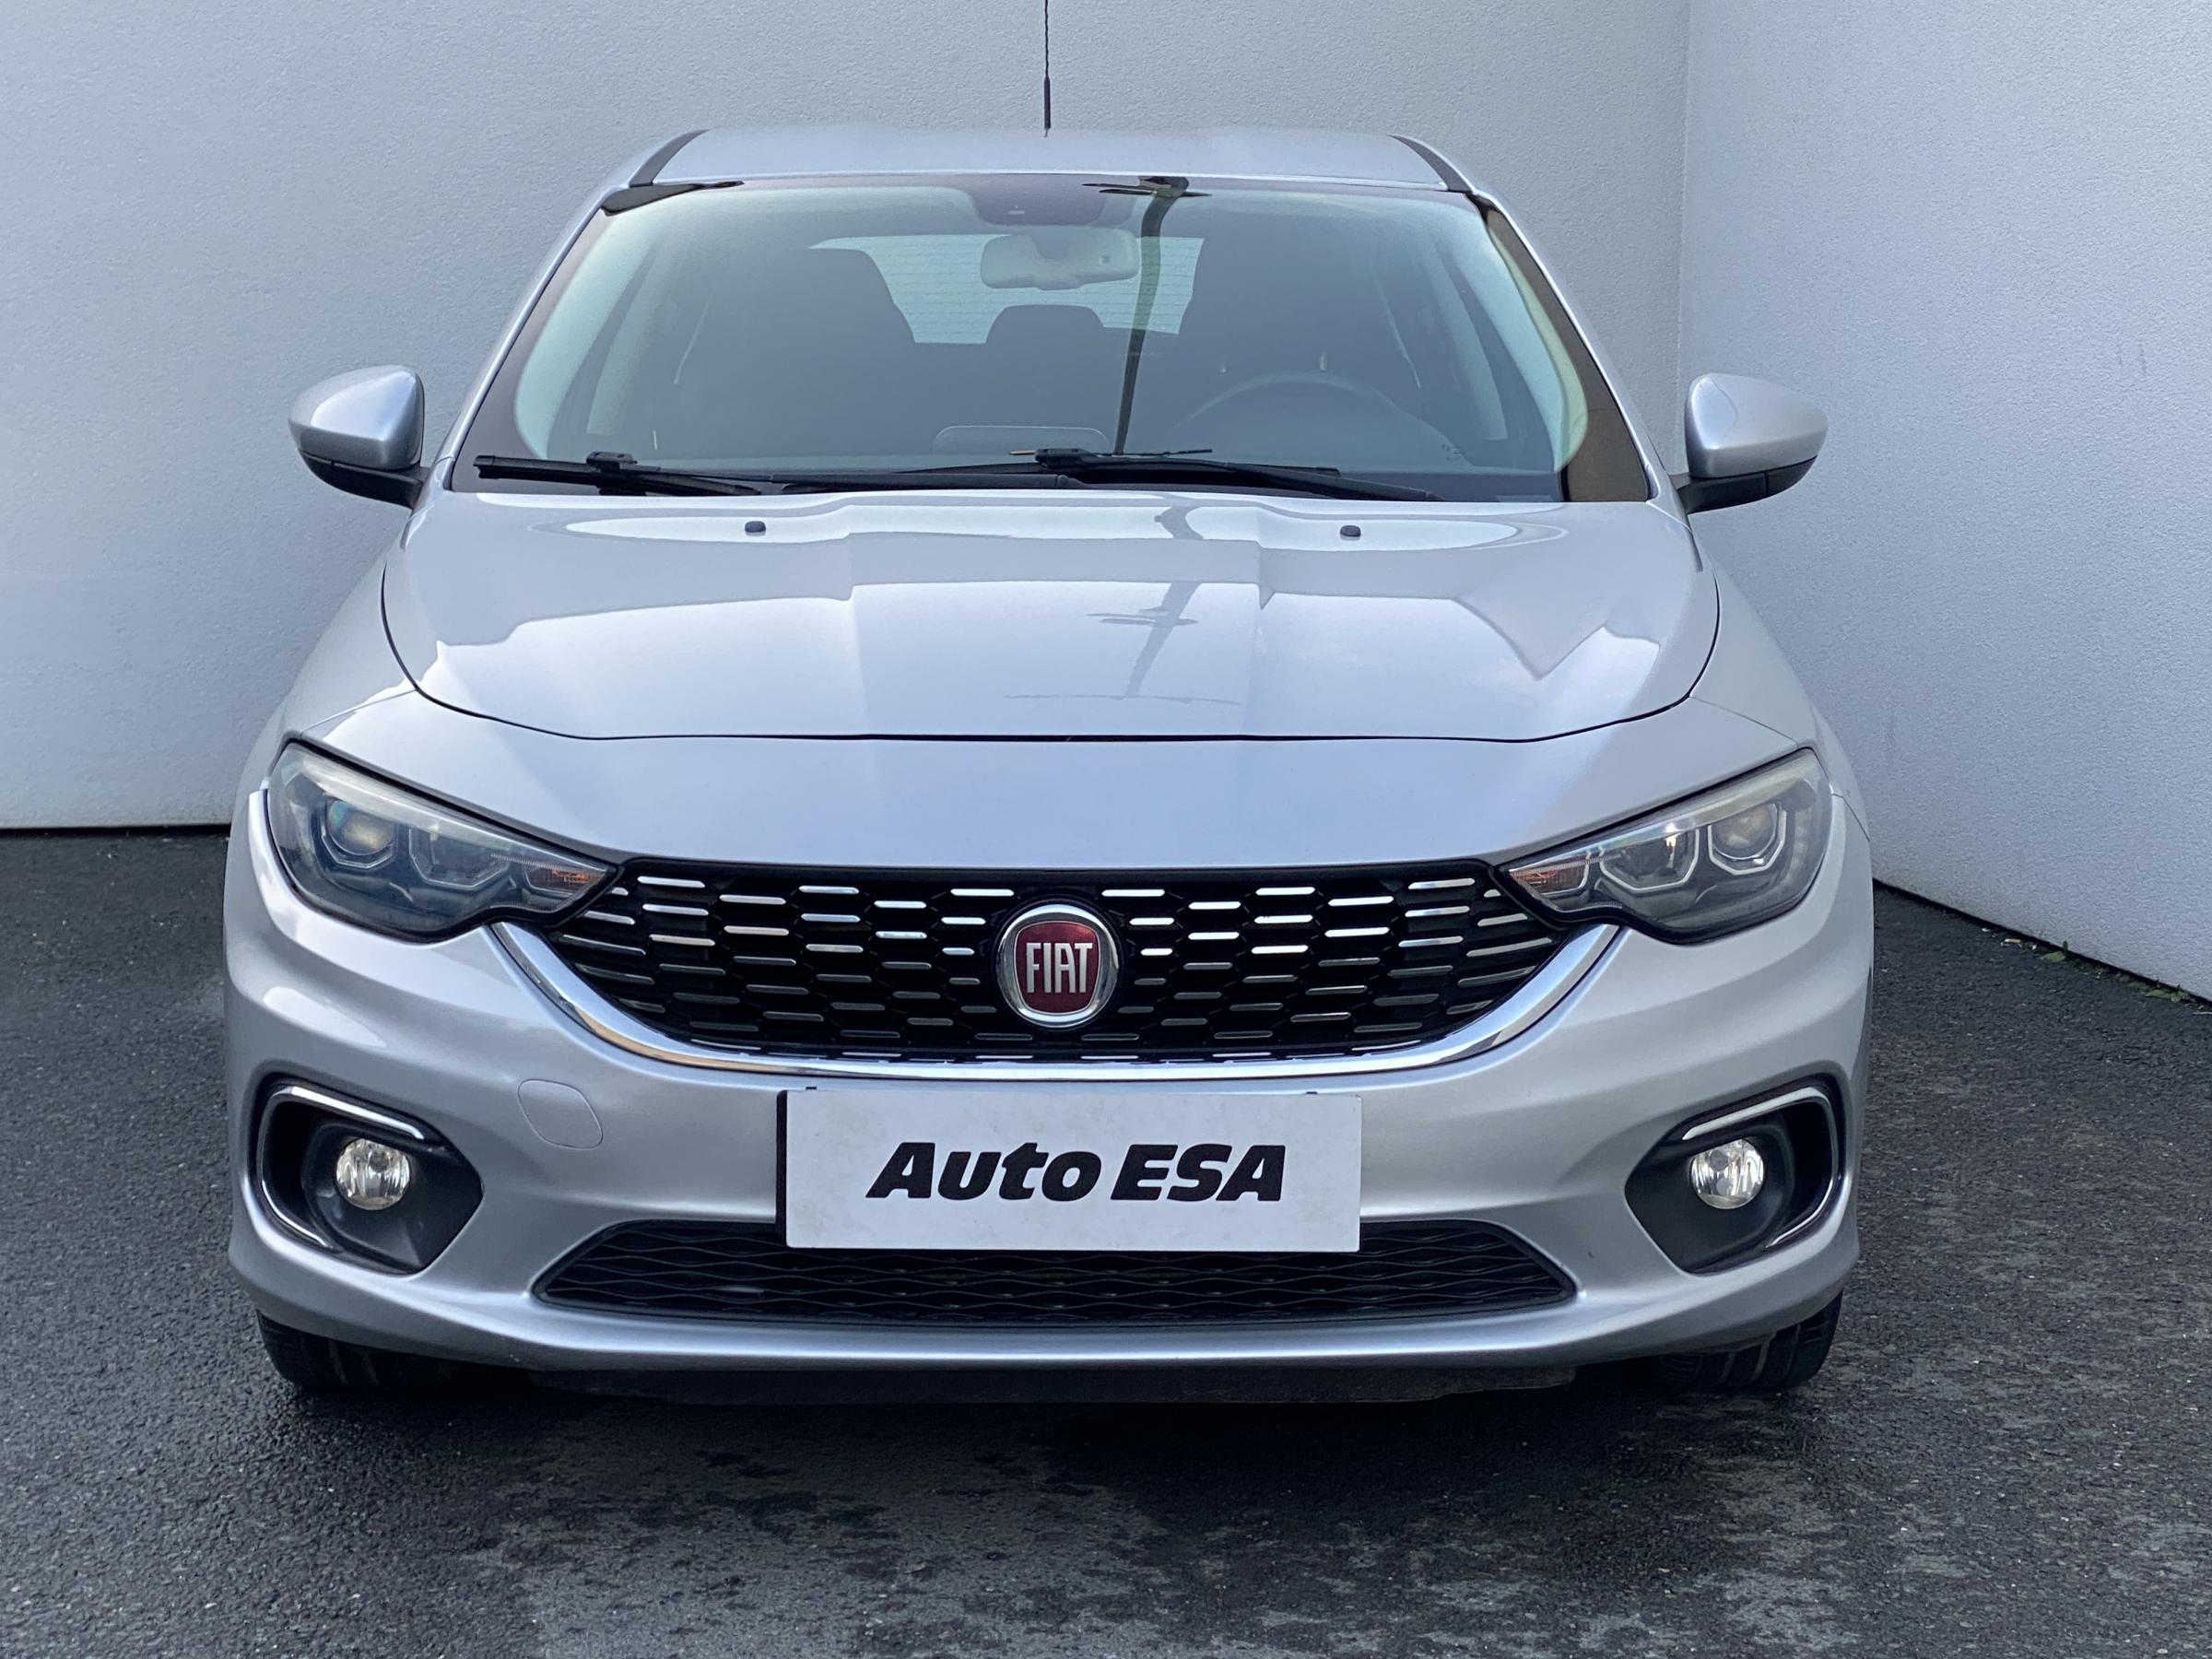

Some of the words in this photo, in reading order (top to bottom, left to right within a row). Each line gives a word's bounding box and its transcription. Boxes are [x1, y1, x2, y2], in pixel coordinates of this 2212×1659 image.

[1026, 942, 1093, 994] FIAT
[865, 1142, 1101, 1201] Auto
[1111, 1144, 1286, 1202] ESA
